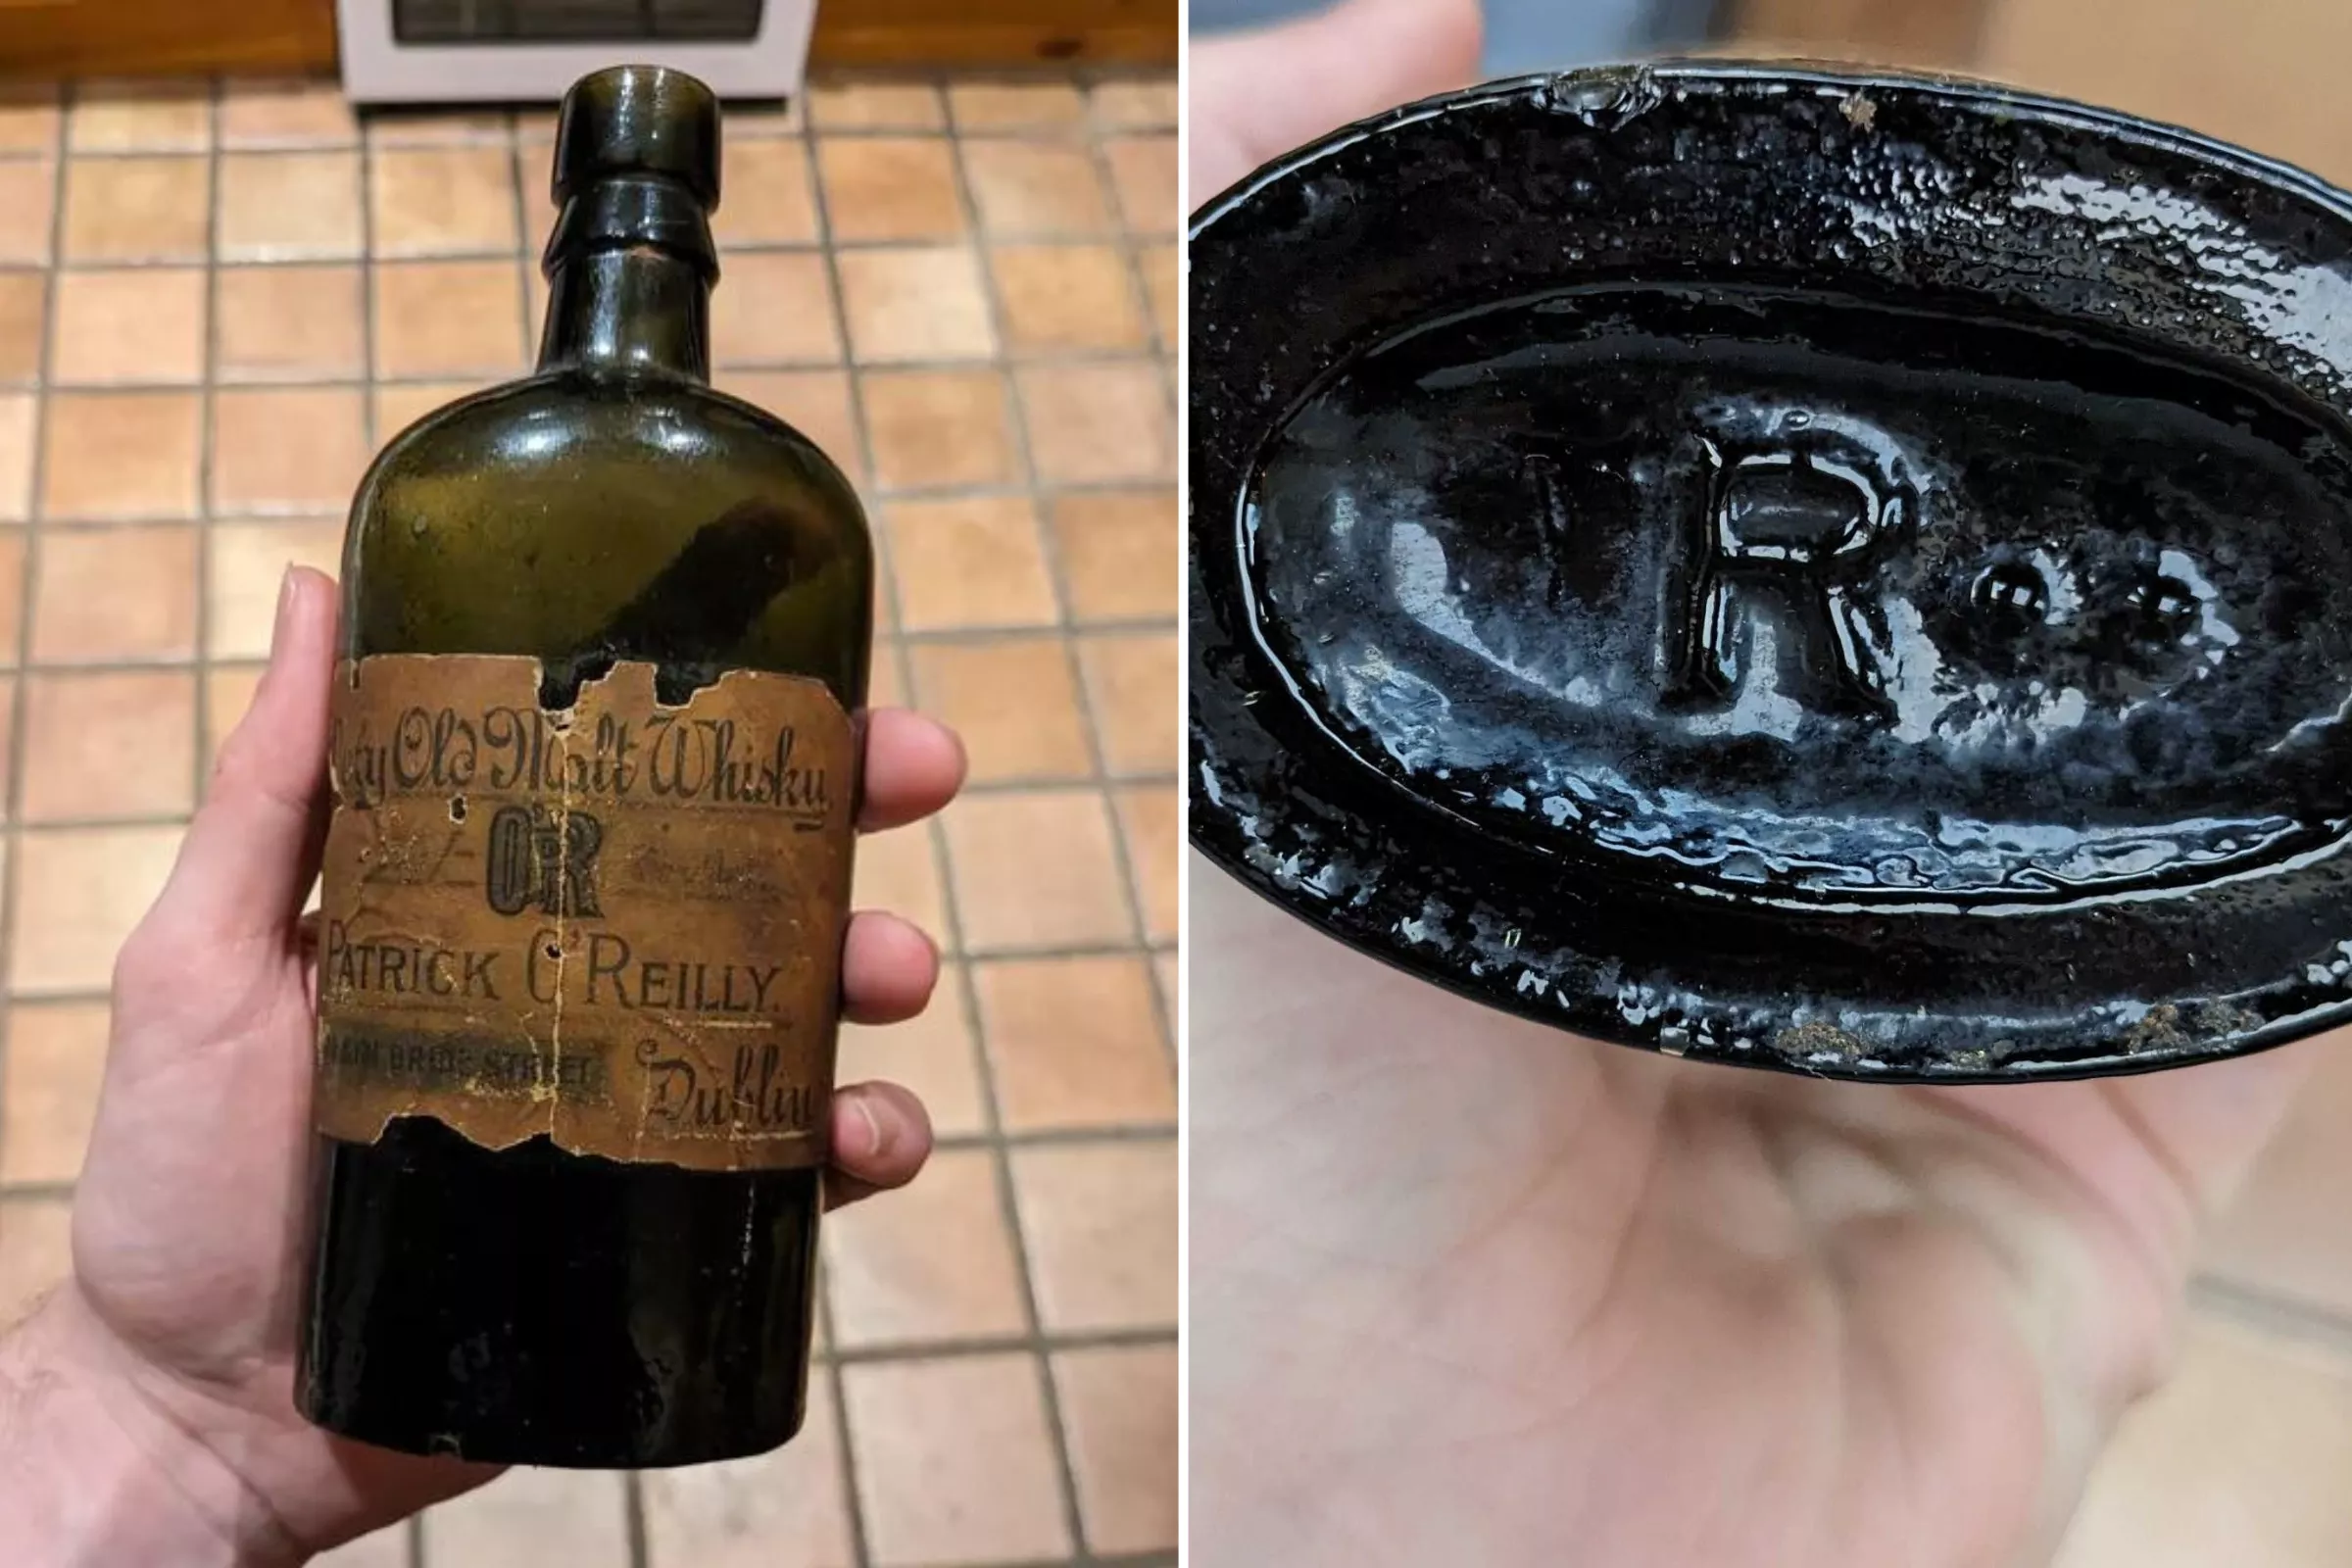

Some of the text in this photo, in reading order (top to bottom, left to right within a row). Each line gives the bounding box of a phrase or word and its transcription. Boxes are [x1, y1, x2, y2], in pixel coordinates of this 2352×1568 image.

[393, 705, 476, 788] Old
[326, 919, 501, 1002] PATRICK
[635, 1037, 812, 1126] Dublin
